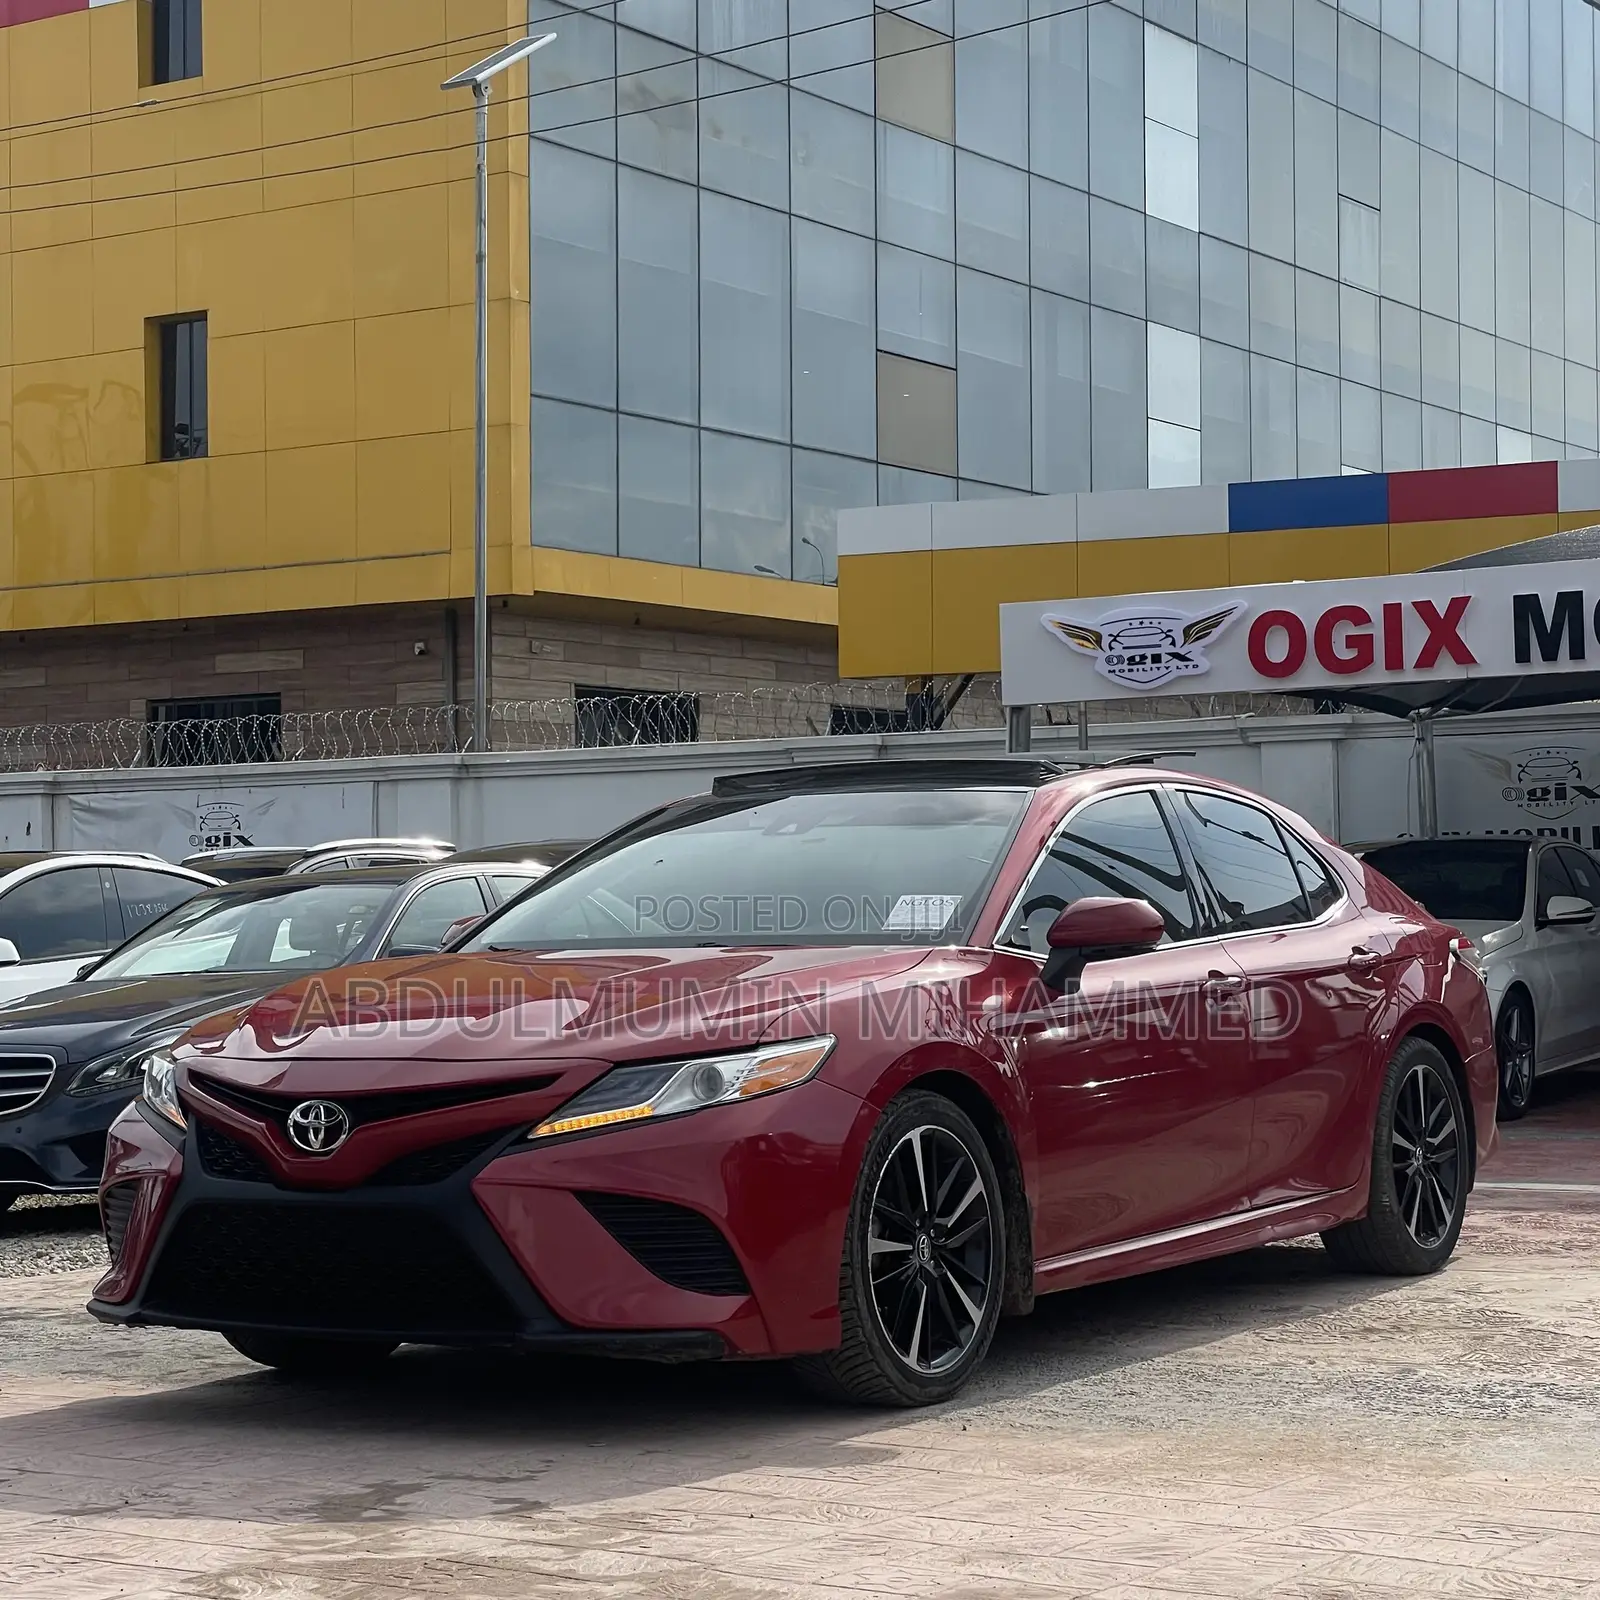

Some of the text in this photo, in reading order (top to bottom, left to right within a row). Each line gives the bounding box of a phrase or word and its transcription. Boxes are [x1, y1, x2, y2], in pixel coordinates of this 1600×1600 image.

[1247, 595, 1479, 679] OGIX
[1107, 663, 1199, 674] MOBILITY LTD
